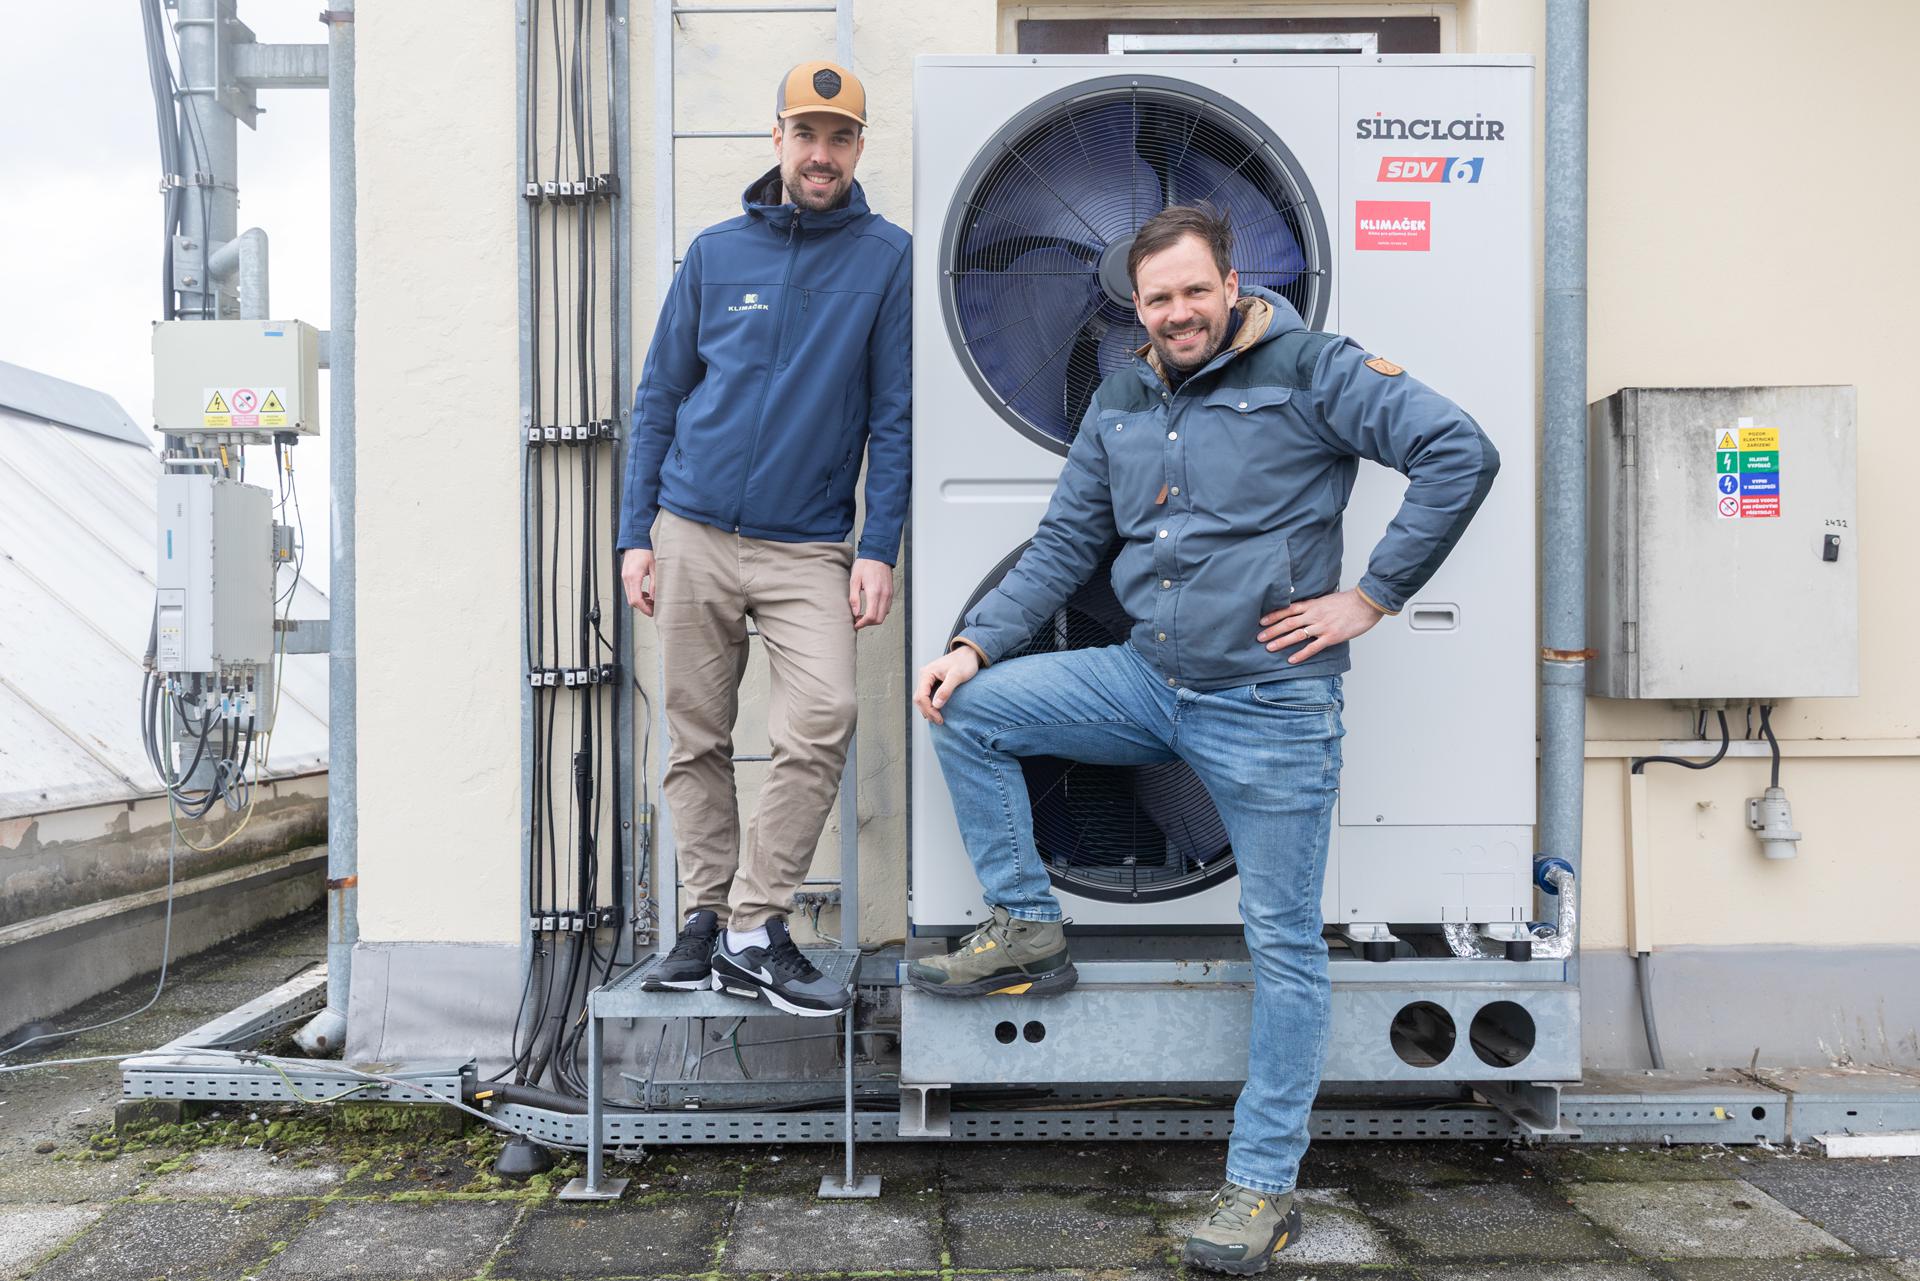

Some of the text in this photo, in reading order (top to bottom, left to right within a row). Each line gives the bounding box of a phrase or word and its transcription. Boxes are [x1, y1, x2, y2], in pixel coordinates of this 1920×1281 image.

[1386, 156, 1474, 183] SDV 6
[1360, 217, 1426, 231] KLIMAČEK
